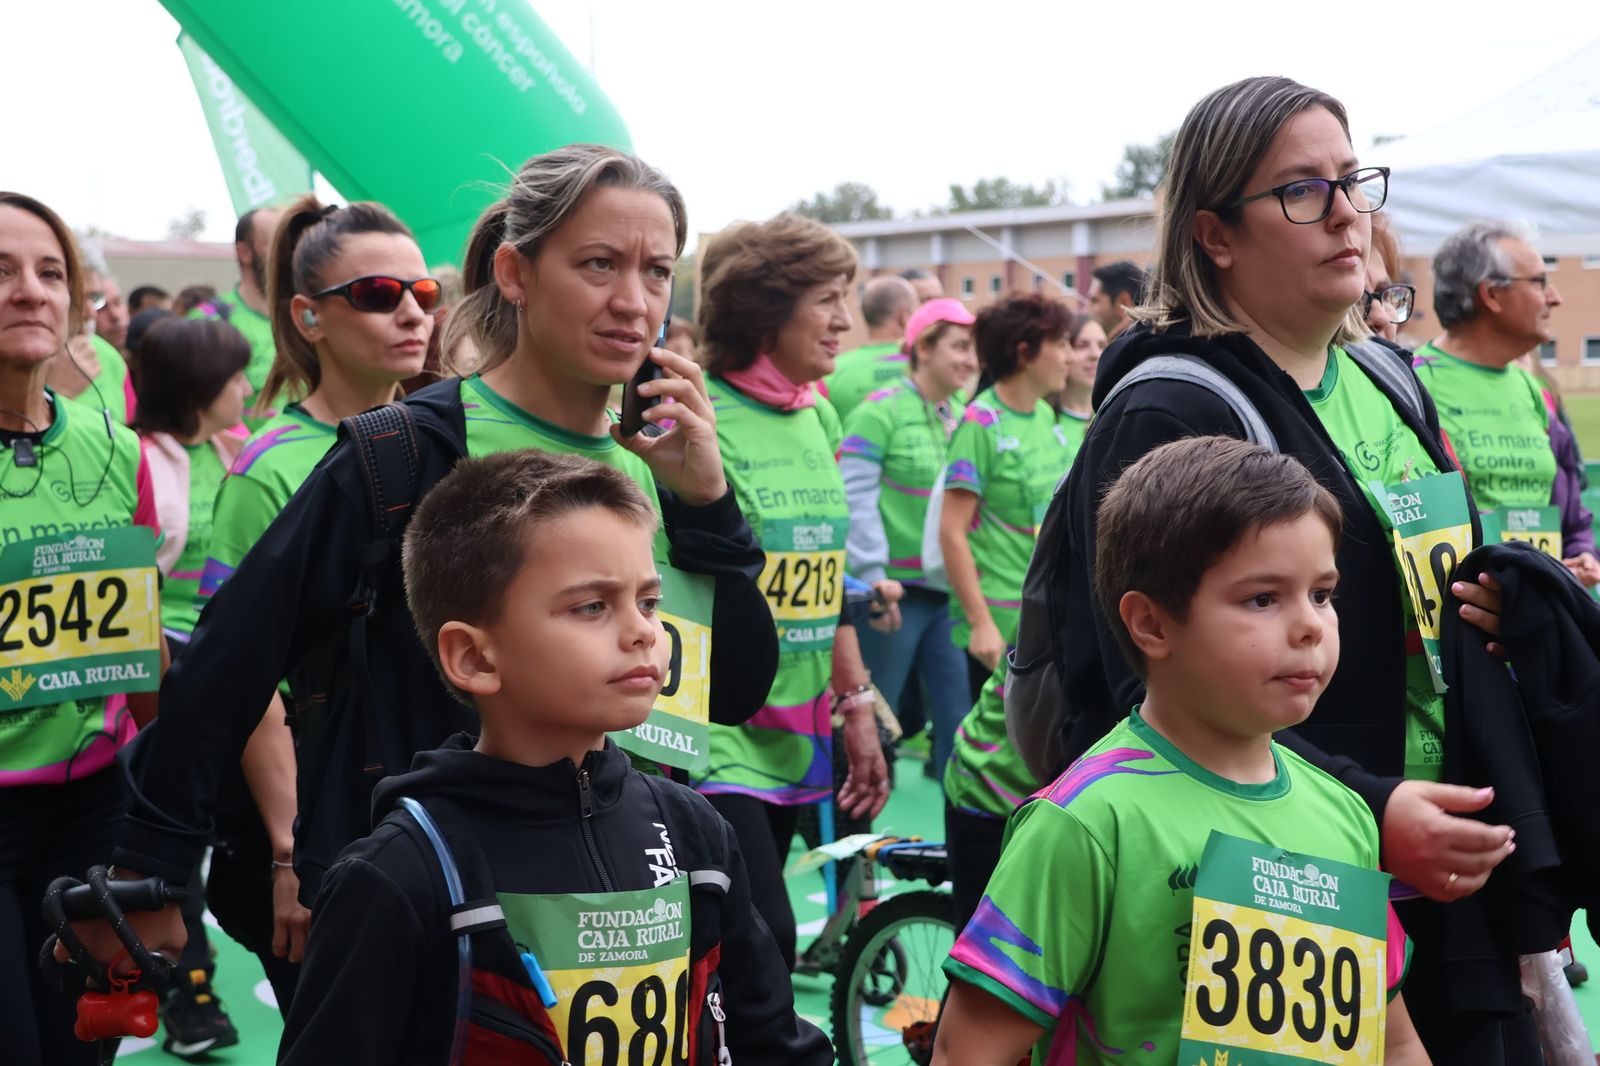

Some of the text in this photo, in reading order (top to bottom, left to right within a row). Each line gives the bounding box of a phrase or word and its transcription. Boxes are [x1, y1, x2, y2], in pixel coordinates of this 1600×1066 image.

[460, 11, 536, 92] cáncer
[1468, 430, 1494, 449] En
[1474, 454, 1535, 470] contra
[756, 486, 788, 509] En
[62, 549, 106, 564] RURAL
[766, 558, 837, 607] 4213
[0, 577, 129, 651] 2542
[38, 662, 150, 690] CAJA RURAL
[634, 722, 699, 757] RURAL
[1253, 874, 1341, 911] CAJA RURAL
[1254, 894, 1304, 915] DE ZAMORA
[577, 921, 684, 949] CAJA RURAL
[578, 949, 649, 963] DE ZAMORA
[1196, 918, 1362, 1051] 3839
